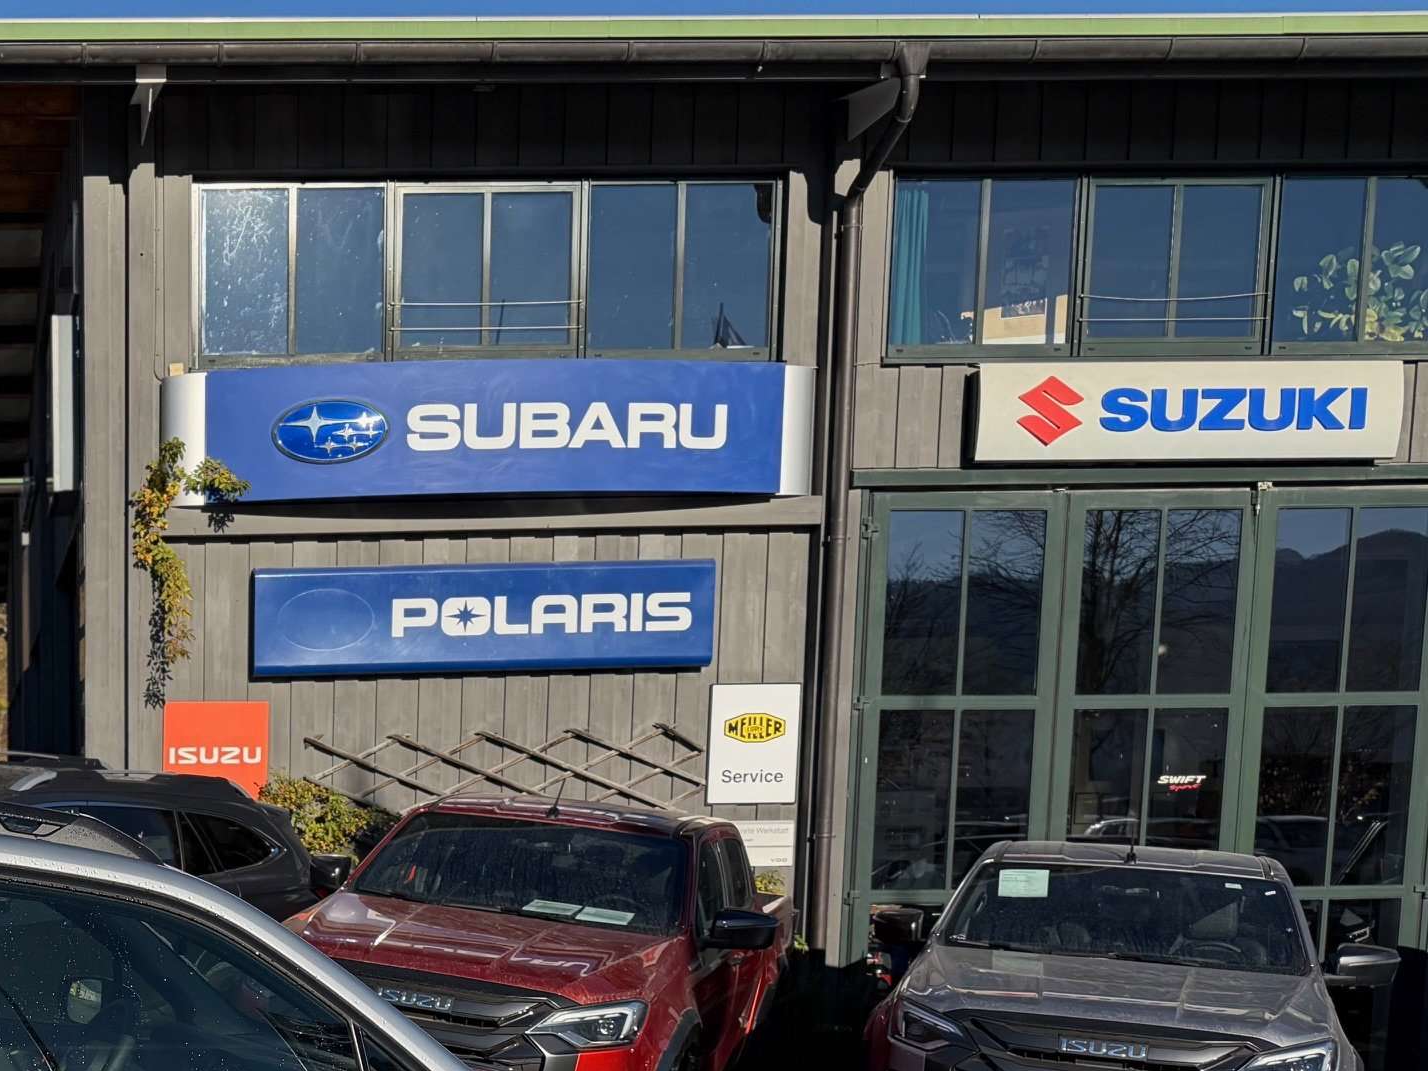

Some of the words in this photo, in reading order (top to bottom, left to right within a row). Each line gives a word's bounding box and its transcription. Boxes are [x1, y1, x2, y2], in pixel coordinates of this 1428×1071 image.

[1099, 386, 1368, 432] SUZUKI
[406, 401, 729, 452] SUBARU
[390, 591, 692, 638] POLARIS
[728, 715, 783, 740] MEILLER
[168, 746, 262, 765] ISUZU
[721, 769, 784, 784] Service
[1157, 775, 1207, 784] SWIFT
[377, 987, 452, 1011] ISUZU
[1059, 1036, 1147, 1059] ISUZU
